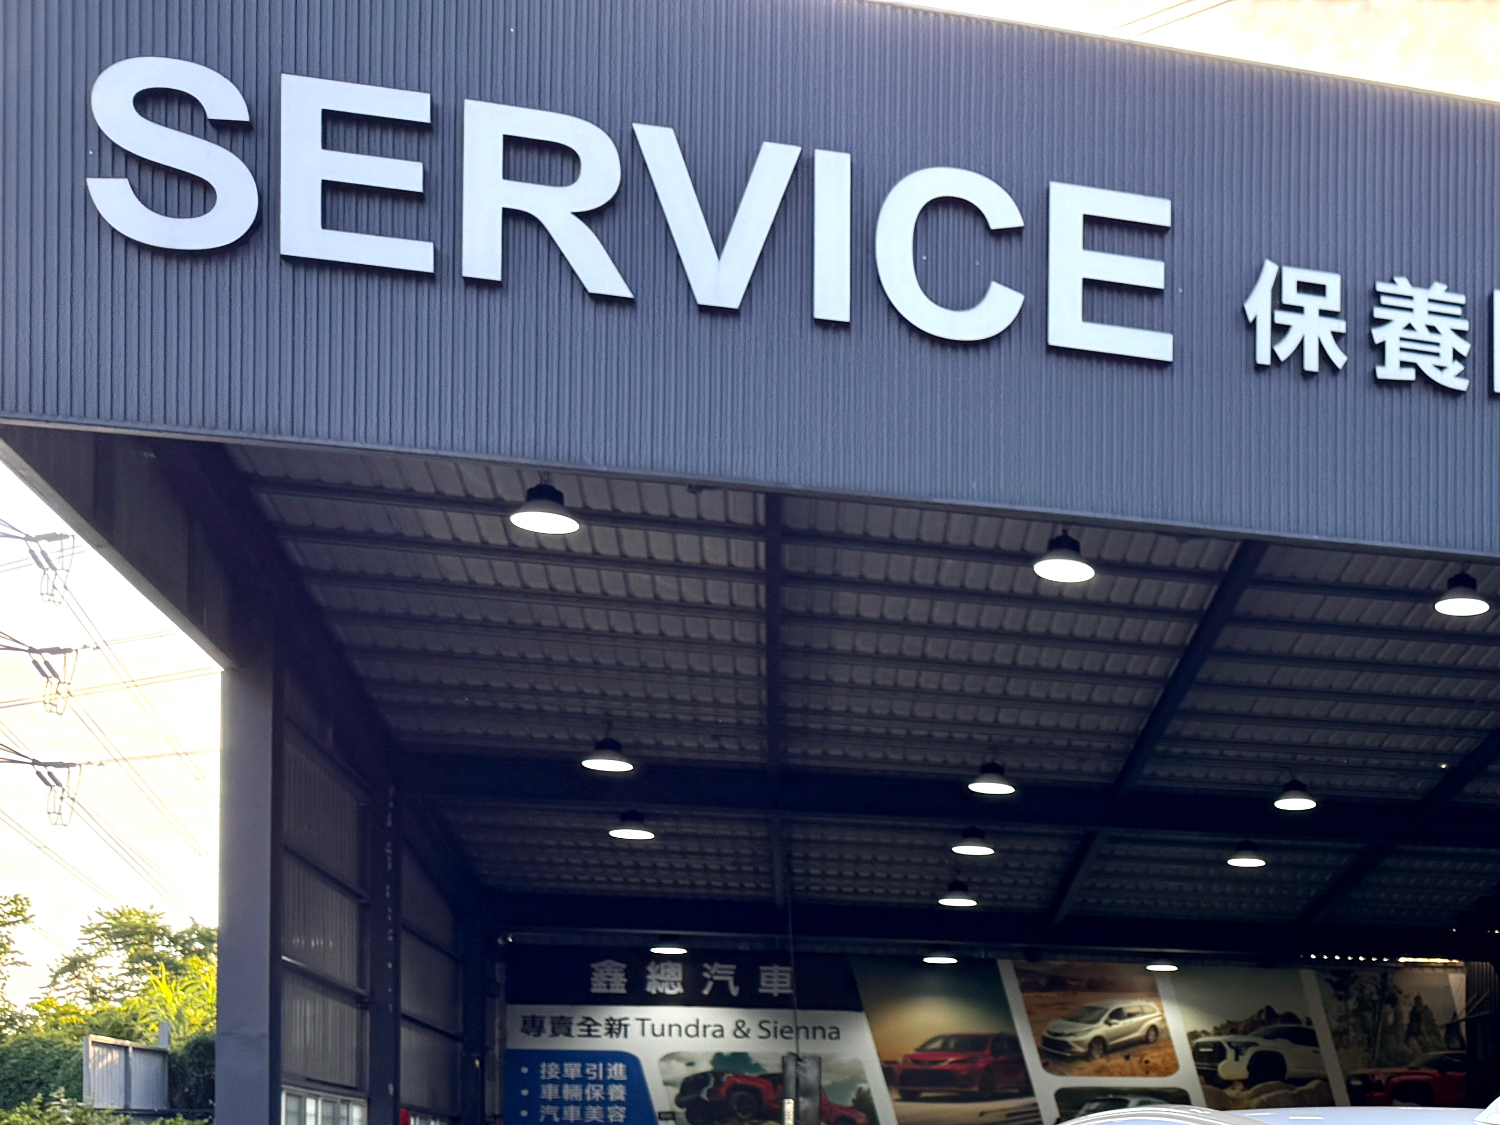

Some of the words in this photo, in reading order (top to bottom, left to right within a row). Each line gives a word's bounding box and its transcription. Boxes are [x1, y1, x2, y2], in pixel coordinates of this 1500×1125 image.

[86, 55, 1174, 362] SERVICE
[589, 959, 794, 997] 鑫總汽車
[520, 1014, 631, 1040] 專賣全新
[636, 1017, 725, 1039] Tundra
[733, 1019, 750, 1040] &
[758, 1019, 841, 1041] Sienna
[539, 1062, 628, 1081] 接單引進
[540, 1083, 627, 1102] 車輛保養
[539, 1105, 627, 1123] 汽車美容
